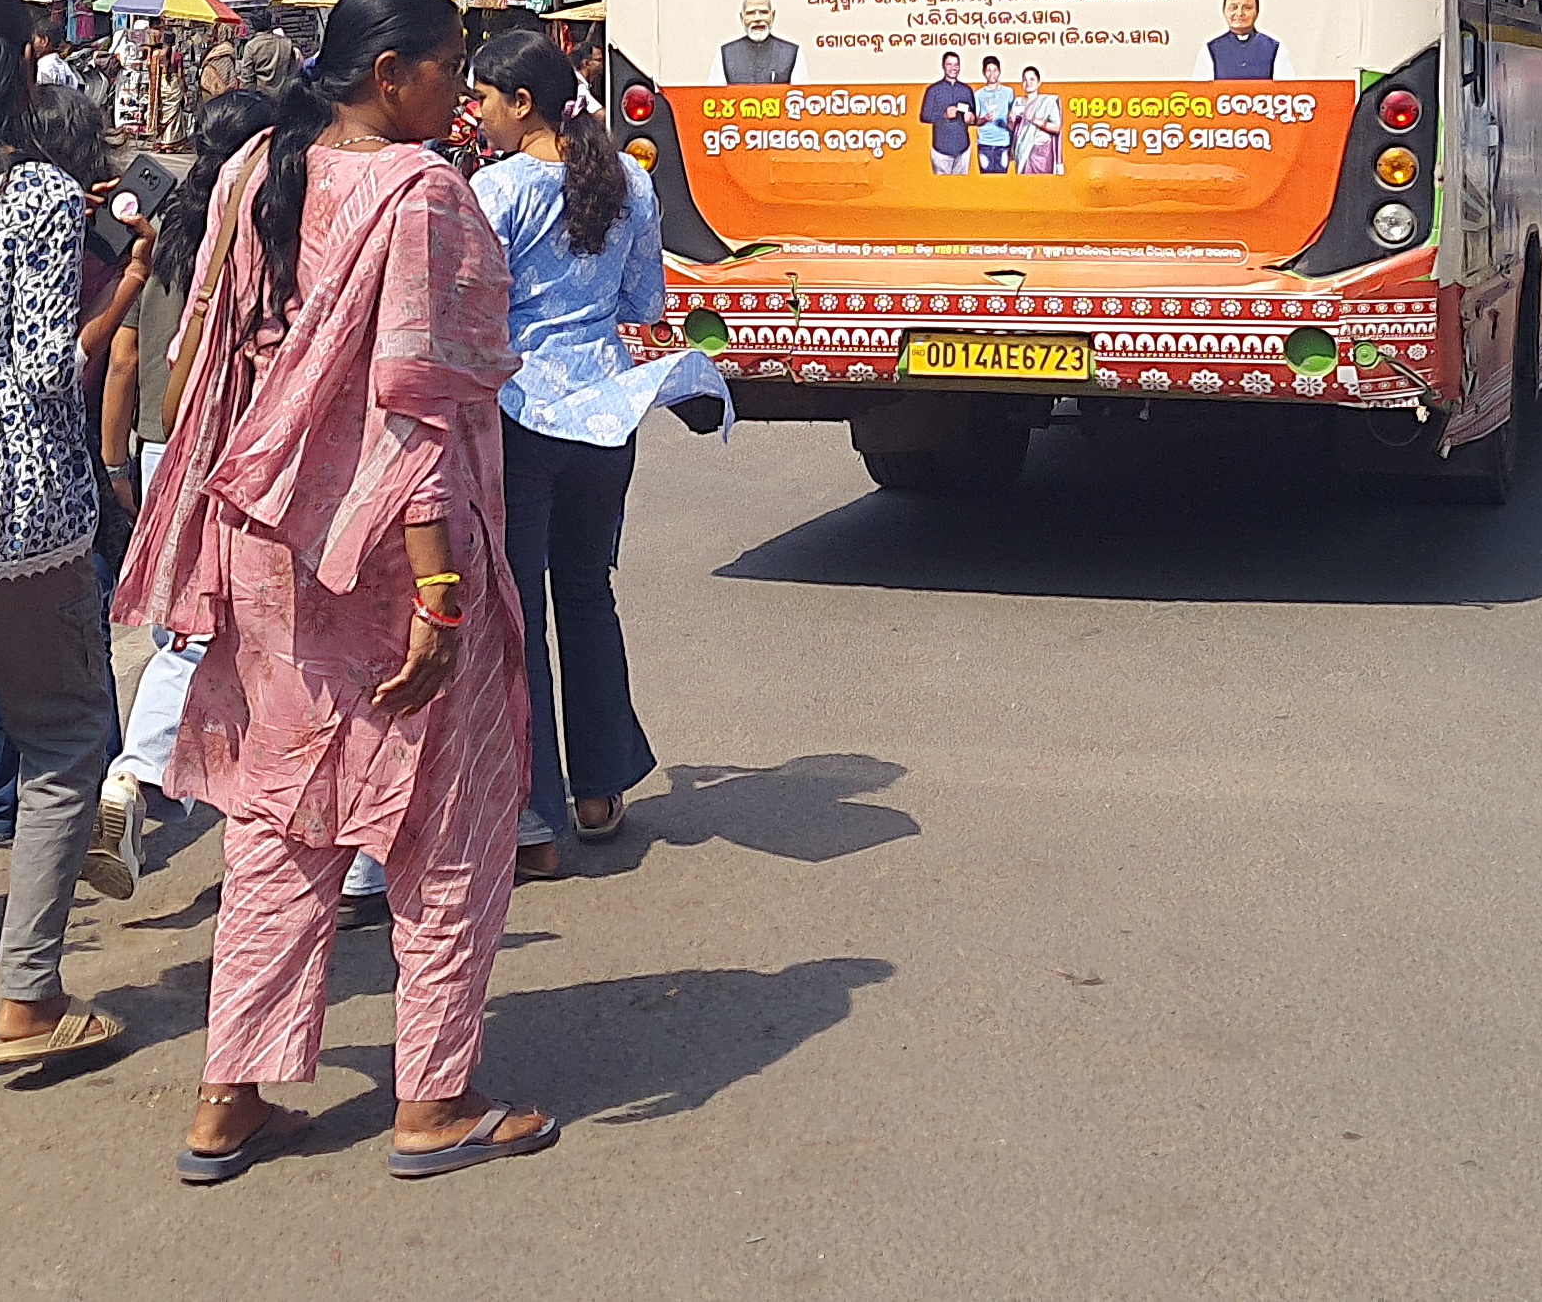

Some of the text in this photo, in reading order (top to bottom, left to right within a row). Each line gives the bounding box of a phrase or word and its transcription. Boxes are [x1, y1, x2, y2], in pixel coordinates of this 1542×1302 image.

[889, 33, 916, 47] ଜନ
[921, 31, 990, 46] ଆରୋଗ୍ୟ
[994, 31, 1055, 46] ଯୋଜନା
[740, 97, 781, 120] ଲକ୍ଷ
[785, 89, 907, 120] ହିତାଧିକାରୀ
[1127, 91, 1213, 119] କୋଟିର
[703, 124, 907, 158] ପ୍ରତି ମାସରେ ଉପକୃତ
[1069, 122, 1271, 154] ଚିକିତ୍ସା ପ୍ରତି ମାସରେ
